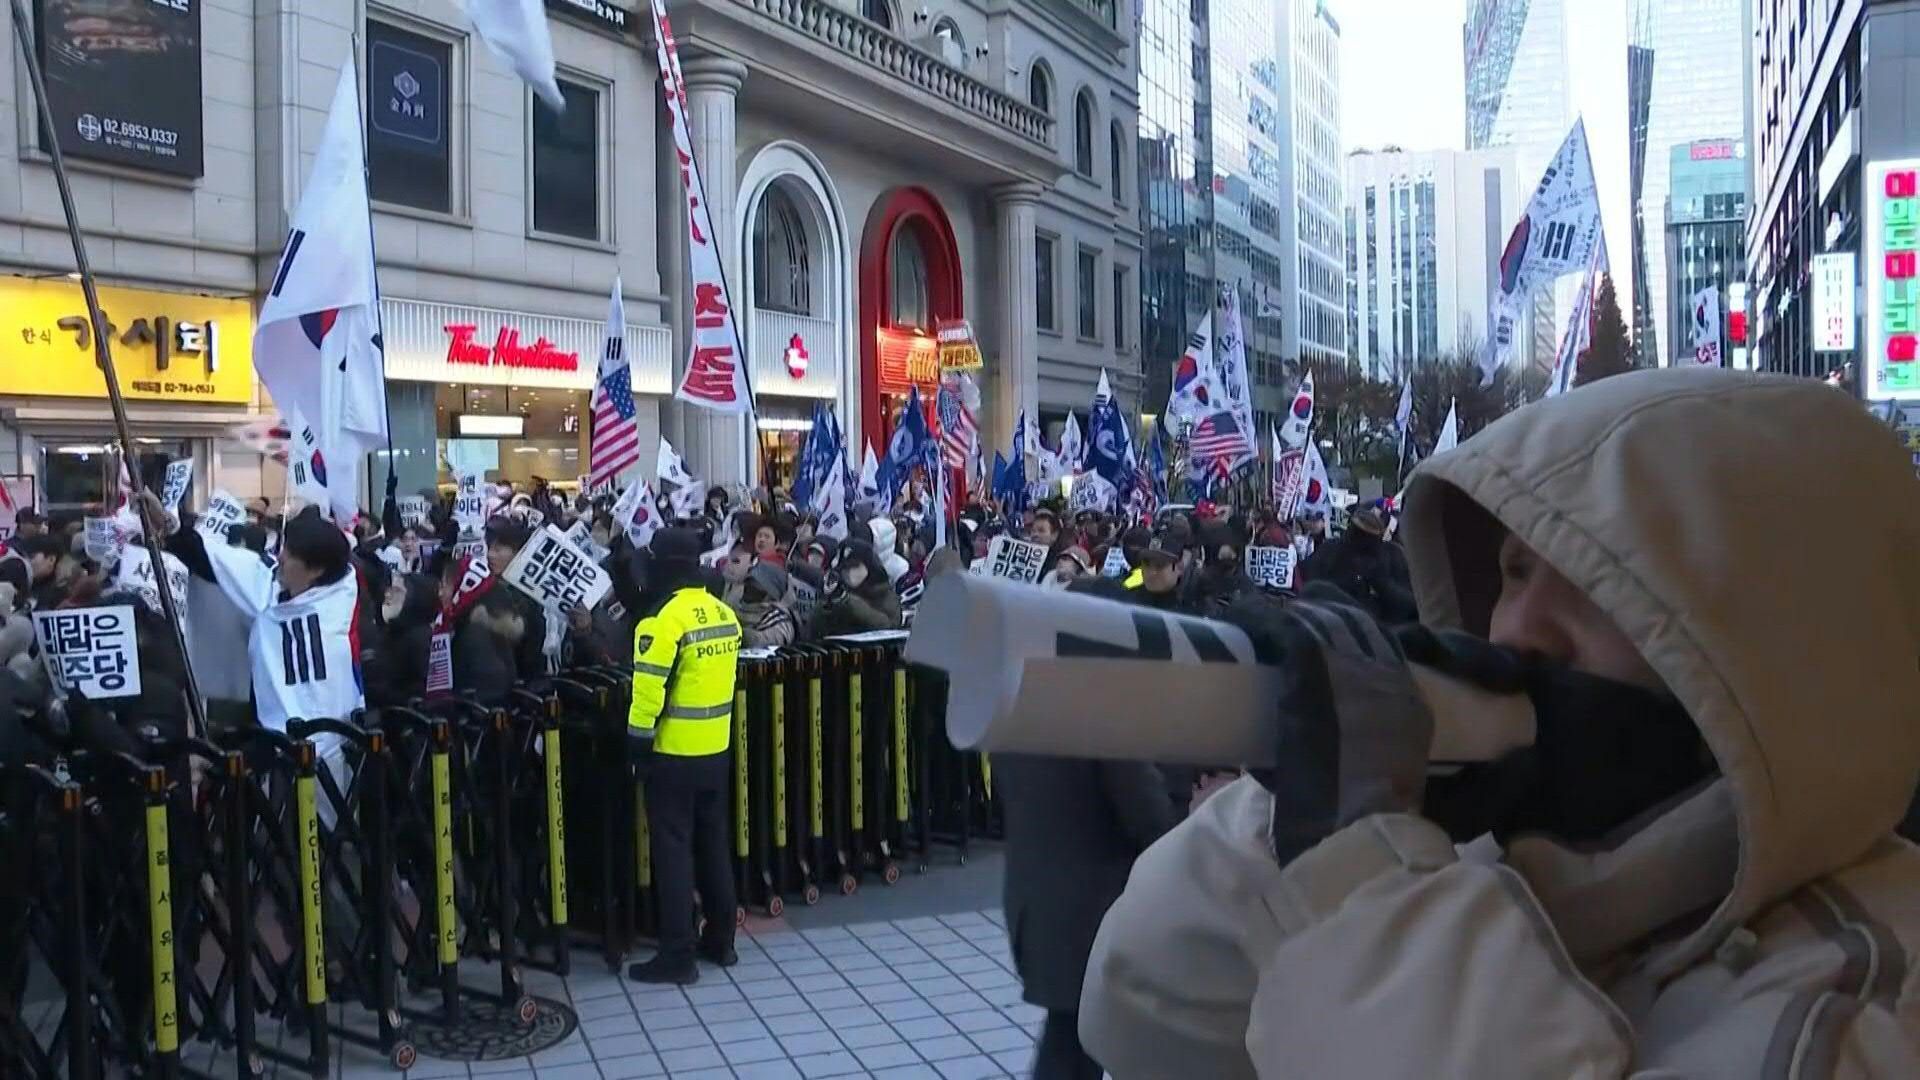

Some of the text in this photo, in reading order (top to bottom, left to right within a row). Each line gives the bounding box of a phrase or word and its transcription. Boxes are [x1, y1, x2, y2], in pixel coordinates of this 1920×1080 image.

[103, 118, 178, 146] 02.6953.0337
[444, 324, 578, 371] Tim Hortons
[307, 818, 322, 908] POLICE
